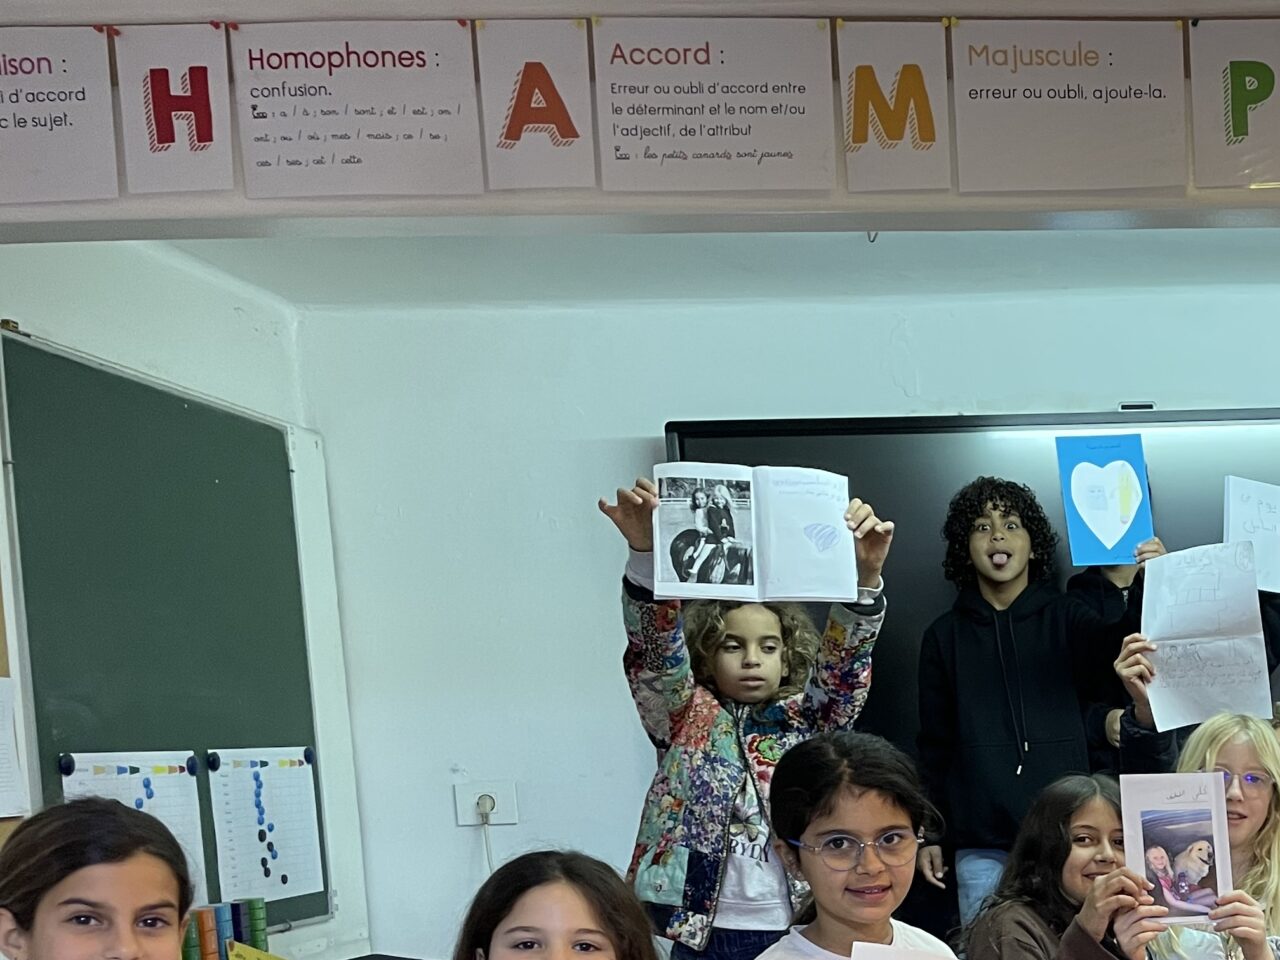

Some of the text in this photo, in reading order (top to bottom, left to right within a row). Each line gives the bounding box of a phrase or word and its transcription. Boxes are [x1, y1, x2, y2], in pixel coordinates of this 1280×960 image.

[248, 41, 427, 77] Homophones
[609, 41, 711, 66] Accord
[967, 40, 1101, 74] Majuscule
[0, 54, 52, 75] ison
[9, 87, 86, 104] d'accord
[250, 81, 333, 99] confusion.
[610, 80, 806, 95] Erreur ou oubli d'accord entre
[968, 83, 1167, 104] erreur ou oubli, ajoute-la.
[143, 64, 214, 152] H
[496, 61, 581, 150] A
[611, 101, 806, 116] le déterminant et le nom et/ou
[845, 63, 937, 153] M
[1222, 60, 1276, 146] P
[13, 112, 27, 128] le
[32, 112, 73, 132] sujet.
[612, 123, 752, 140] l'adjectif, de l'attribut
[643, 145, 659, 159] les
[660, 149, 689, 166] petits
[691, 147, 733, 160] canards
[736, 148, 758, 159] sont
[757, 149, 795, 166] jaunes
